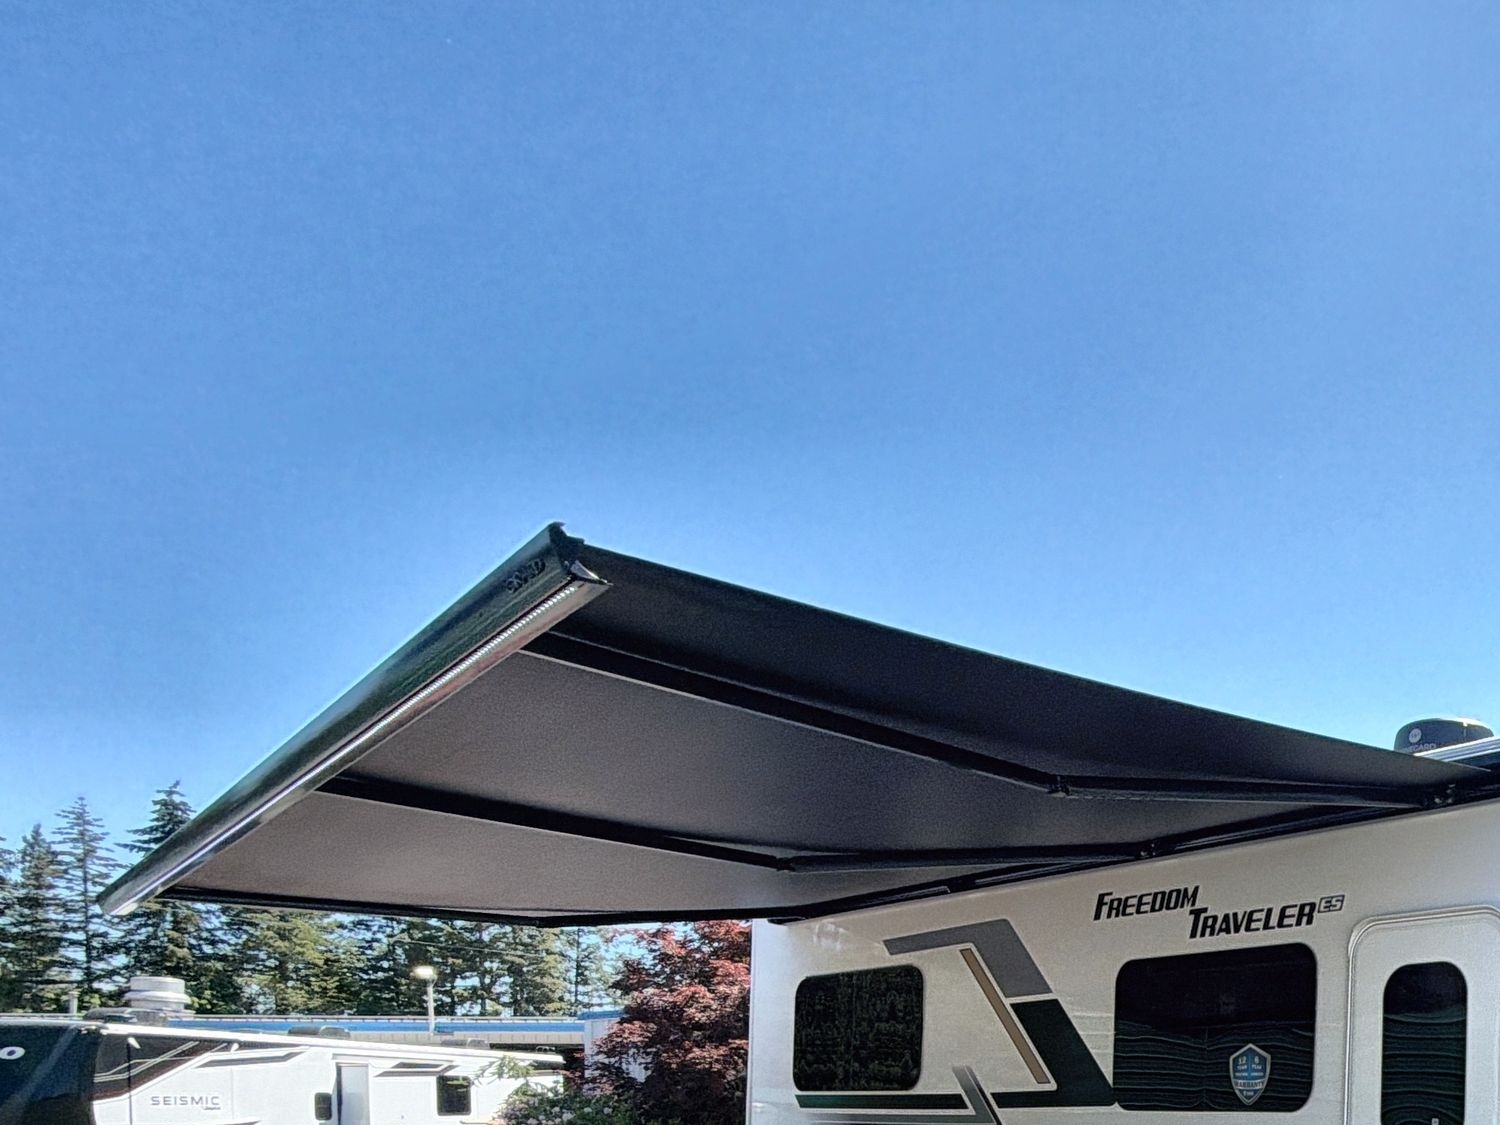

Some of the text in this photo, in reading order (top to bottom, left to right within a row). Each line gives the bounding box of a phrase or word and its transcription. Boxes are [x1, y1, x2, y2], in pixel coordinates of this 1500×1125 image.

[1093, 886, 1200, 921] FREEDOM
[1189, 895, 1345, 939] TRAVELER ES
[151, 1095, 220, 1106] SEISMIC
